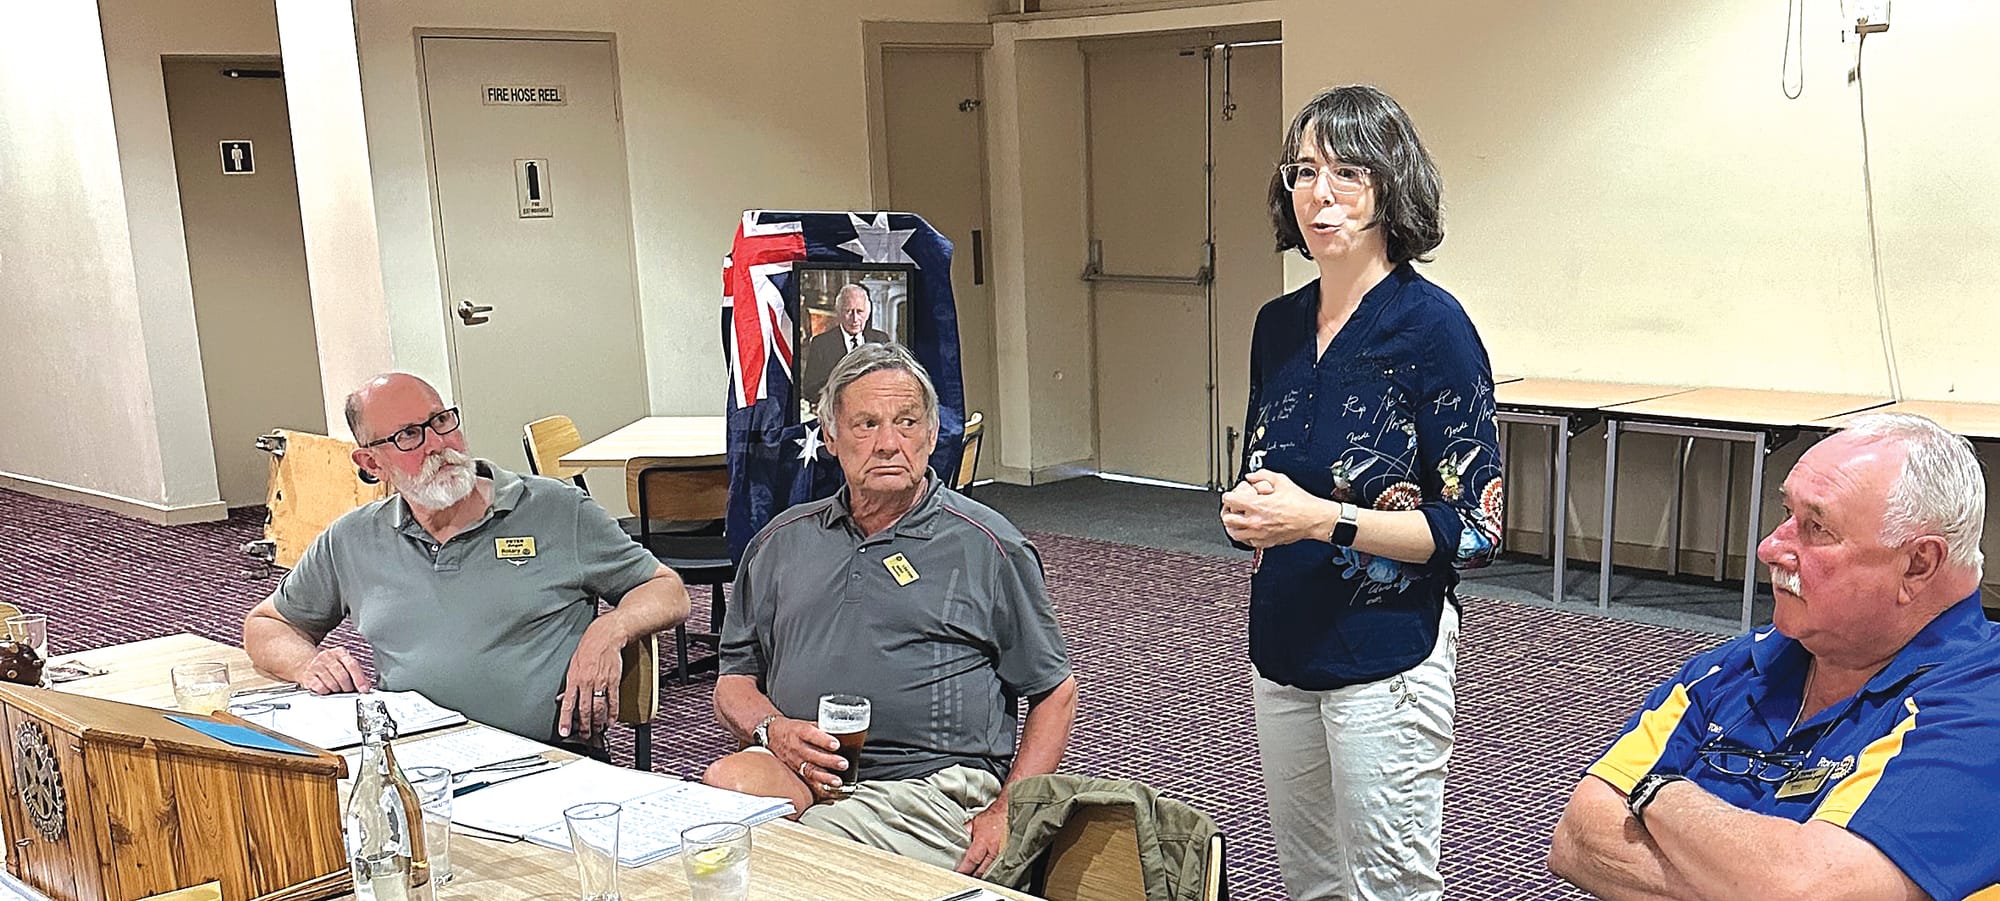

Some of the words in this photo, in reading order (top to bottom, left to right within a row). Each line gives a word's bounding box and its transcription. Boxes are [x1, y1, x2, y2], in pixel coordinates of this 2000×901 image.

[487, 87, 509, 102] FIRE
[511, 88, 537, 102] HOSE
[538, 88, 562, 102] REEL
